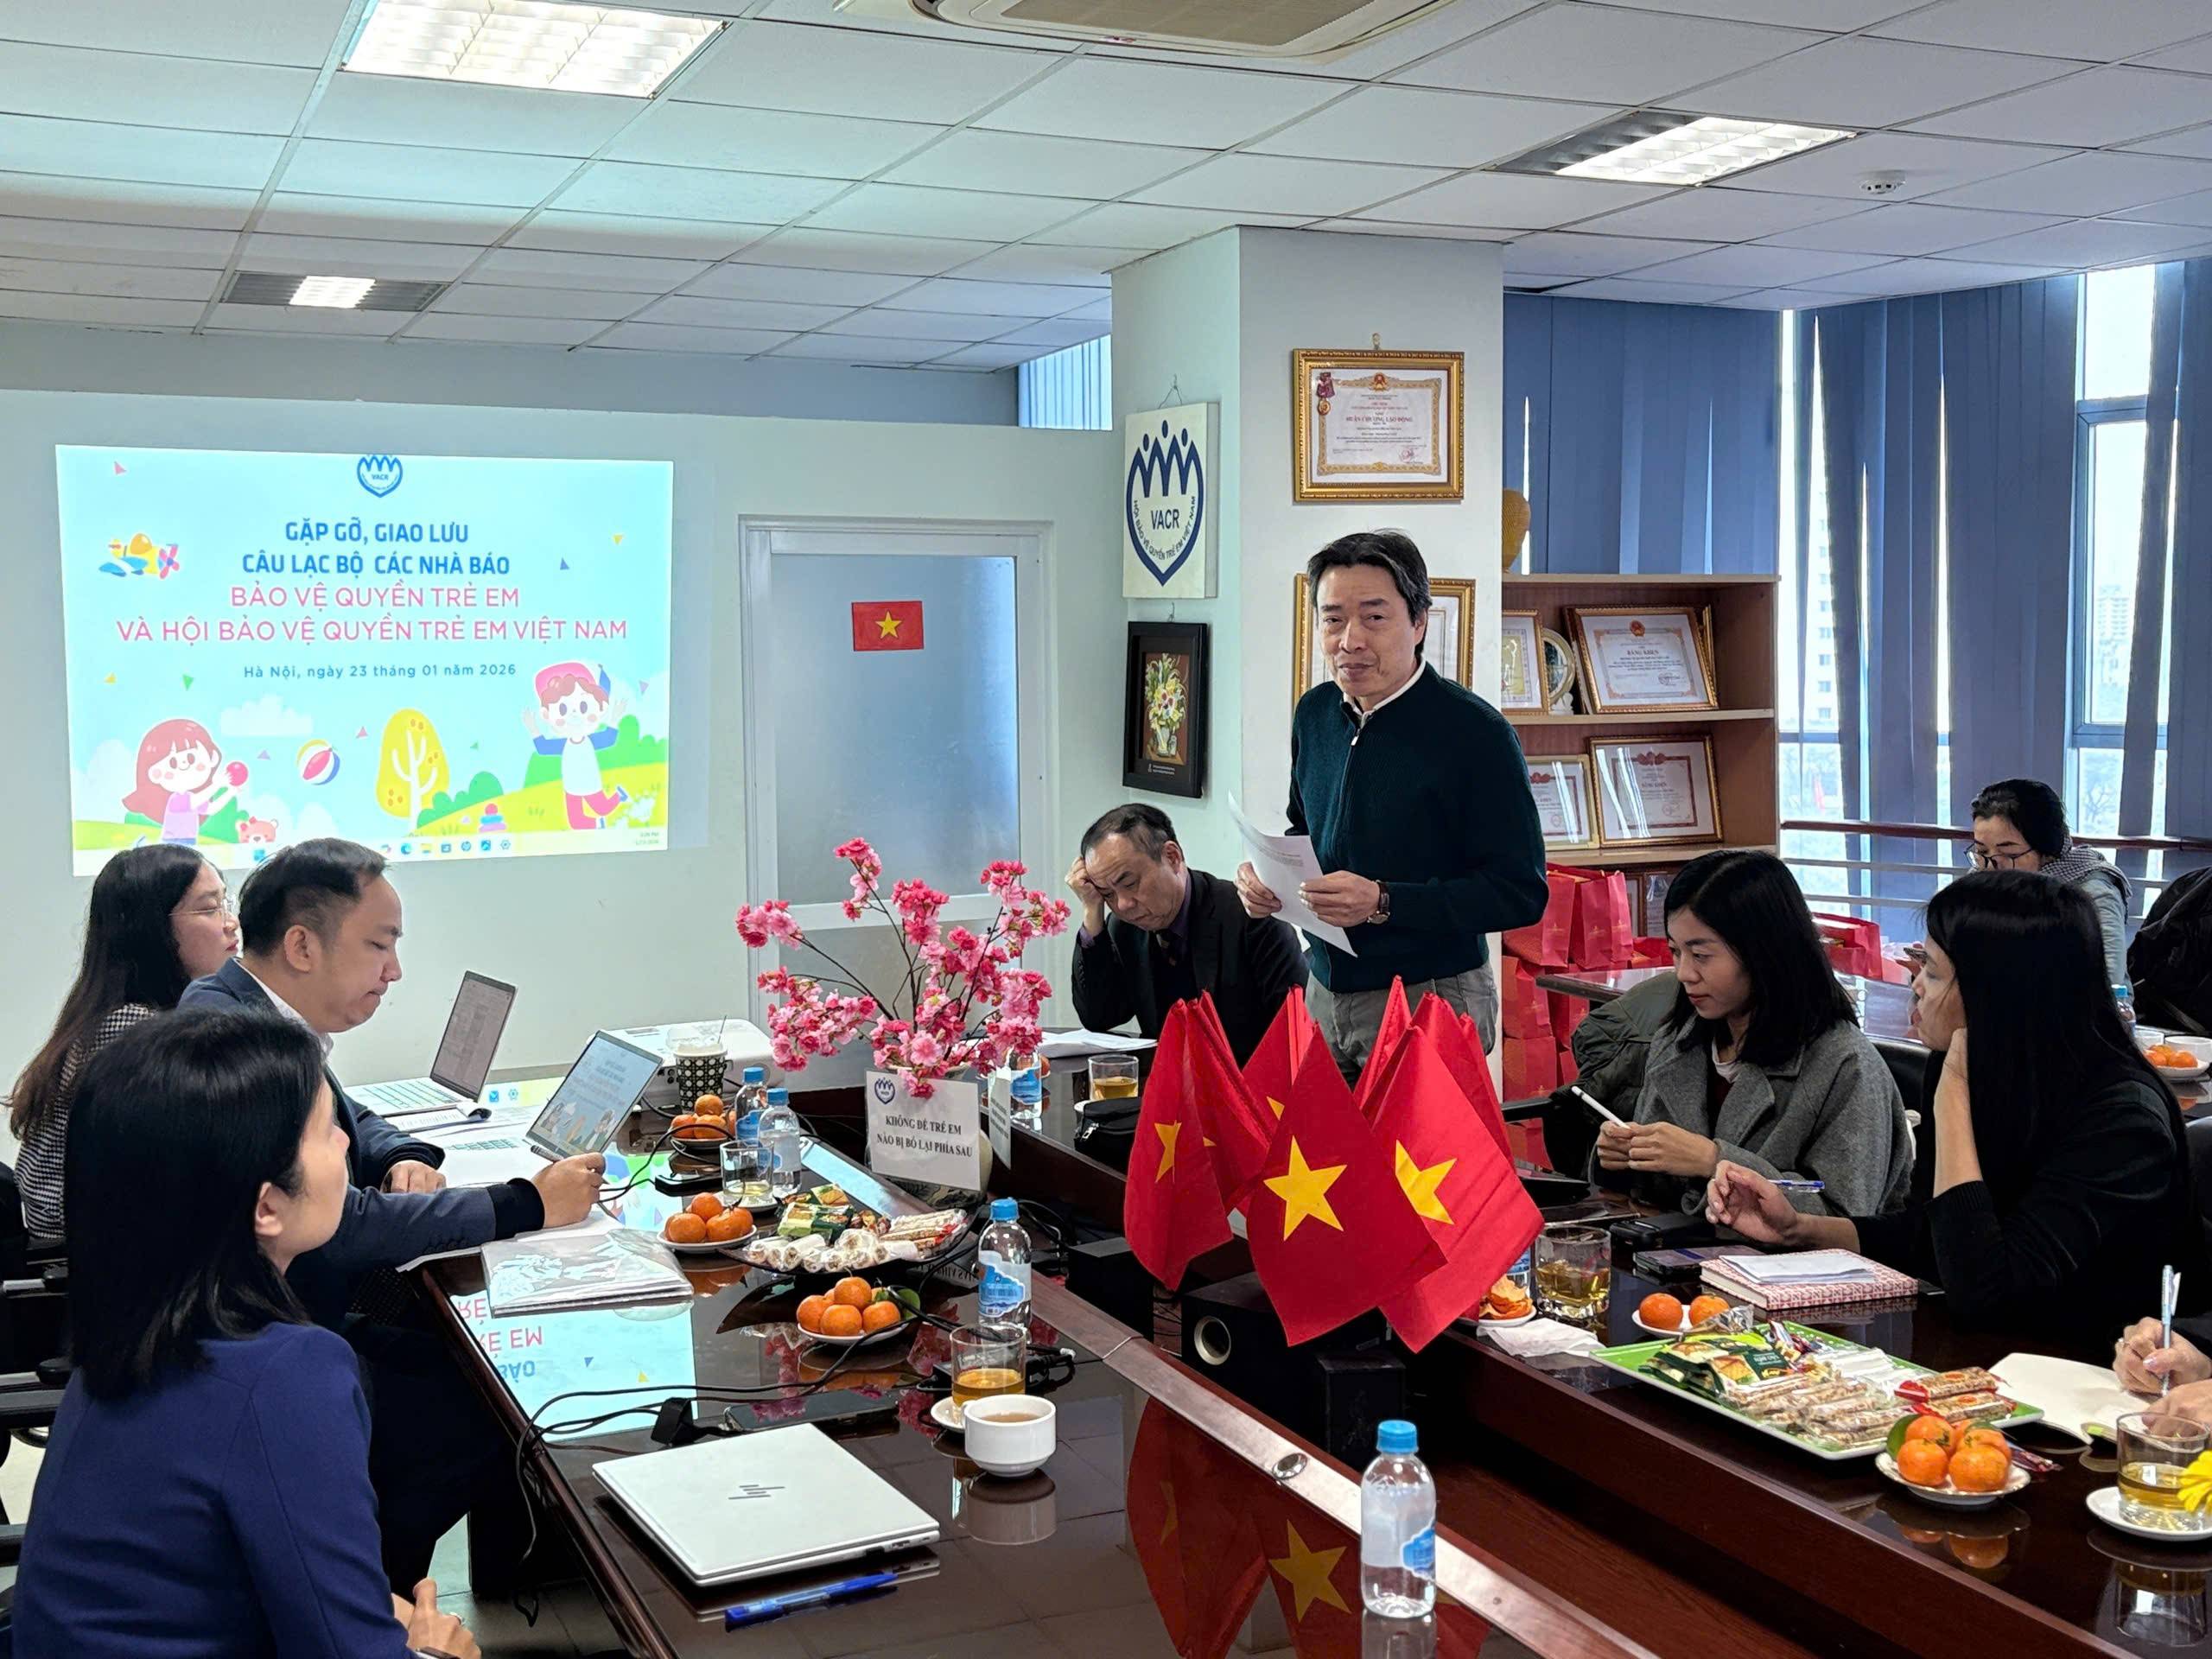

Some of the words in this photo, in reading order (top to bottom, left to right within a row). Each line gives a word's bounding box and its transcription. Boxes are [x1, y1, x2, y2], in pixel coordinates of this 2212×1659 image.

[285, 518, 328, 546] GẶP
[334, 517, 369, 544] GỠ,
[374, 523, 423, 543] GIAO
[429, 521, 469, 543] LƯU
[1150, 508, 1179, 530] VACR
[242, 550, 284, 574] CÂU
[291, 554, 330, 579] LẠC
[336, 550, 364, 579] BỘ
[374, 551, 413, 575] CÁC
[420, 551, 464, 575] NHÀ
[469, 551, 511, 575] BÁO
[231, 581, 289, 607] BẢO
[294, 582, 327, 612] VỆ
[335, 579, 423, 607] QUYỀN
[430, 582, 478, 607] TRẺ
[486, 588, 520, 607] EM
[116, 616, 153, 641] VÀ
[162, 615, 209, 646] HỘI
[219, 614, 276, 641] BẢO
[282, 615, 315, 645] VỆ
[323, 612, 412, 641] QUYỀN
[418, 614, 466, 640] TRẺ
[474, 621, 507, 640] EM
[513, 615, 567, 645] VIỆT
[575, 620, 627, 639] NAM
[245, 664, 264, 678] Hà
[270, 665, 301, 681] Nội,
[307, 665, 343, 679] ngày
[349, 665, 368, 677] 23
[373, 664, 416, 679] tháng
[422, 665, 438, 677] 01
[444, 665, 474, 677] năm
[480, 664, 517, 677] 2026
[885, 1114, 916, 1130] KHÔNG
[930, 1121, 947, 1133] TRẺ
[948, 1124, 962, 1135] EM
[876, 1132, 894, 1146] NÀO
[895, 1135, 904, 1149] BỊ
[906, 1135, 917, 1149] BỎ
[918, 1139, 933, 1153] LẠI
[934, 1141, 955, 1156] PHÍA
[955, 1145, 973, 1157] SAU
